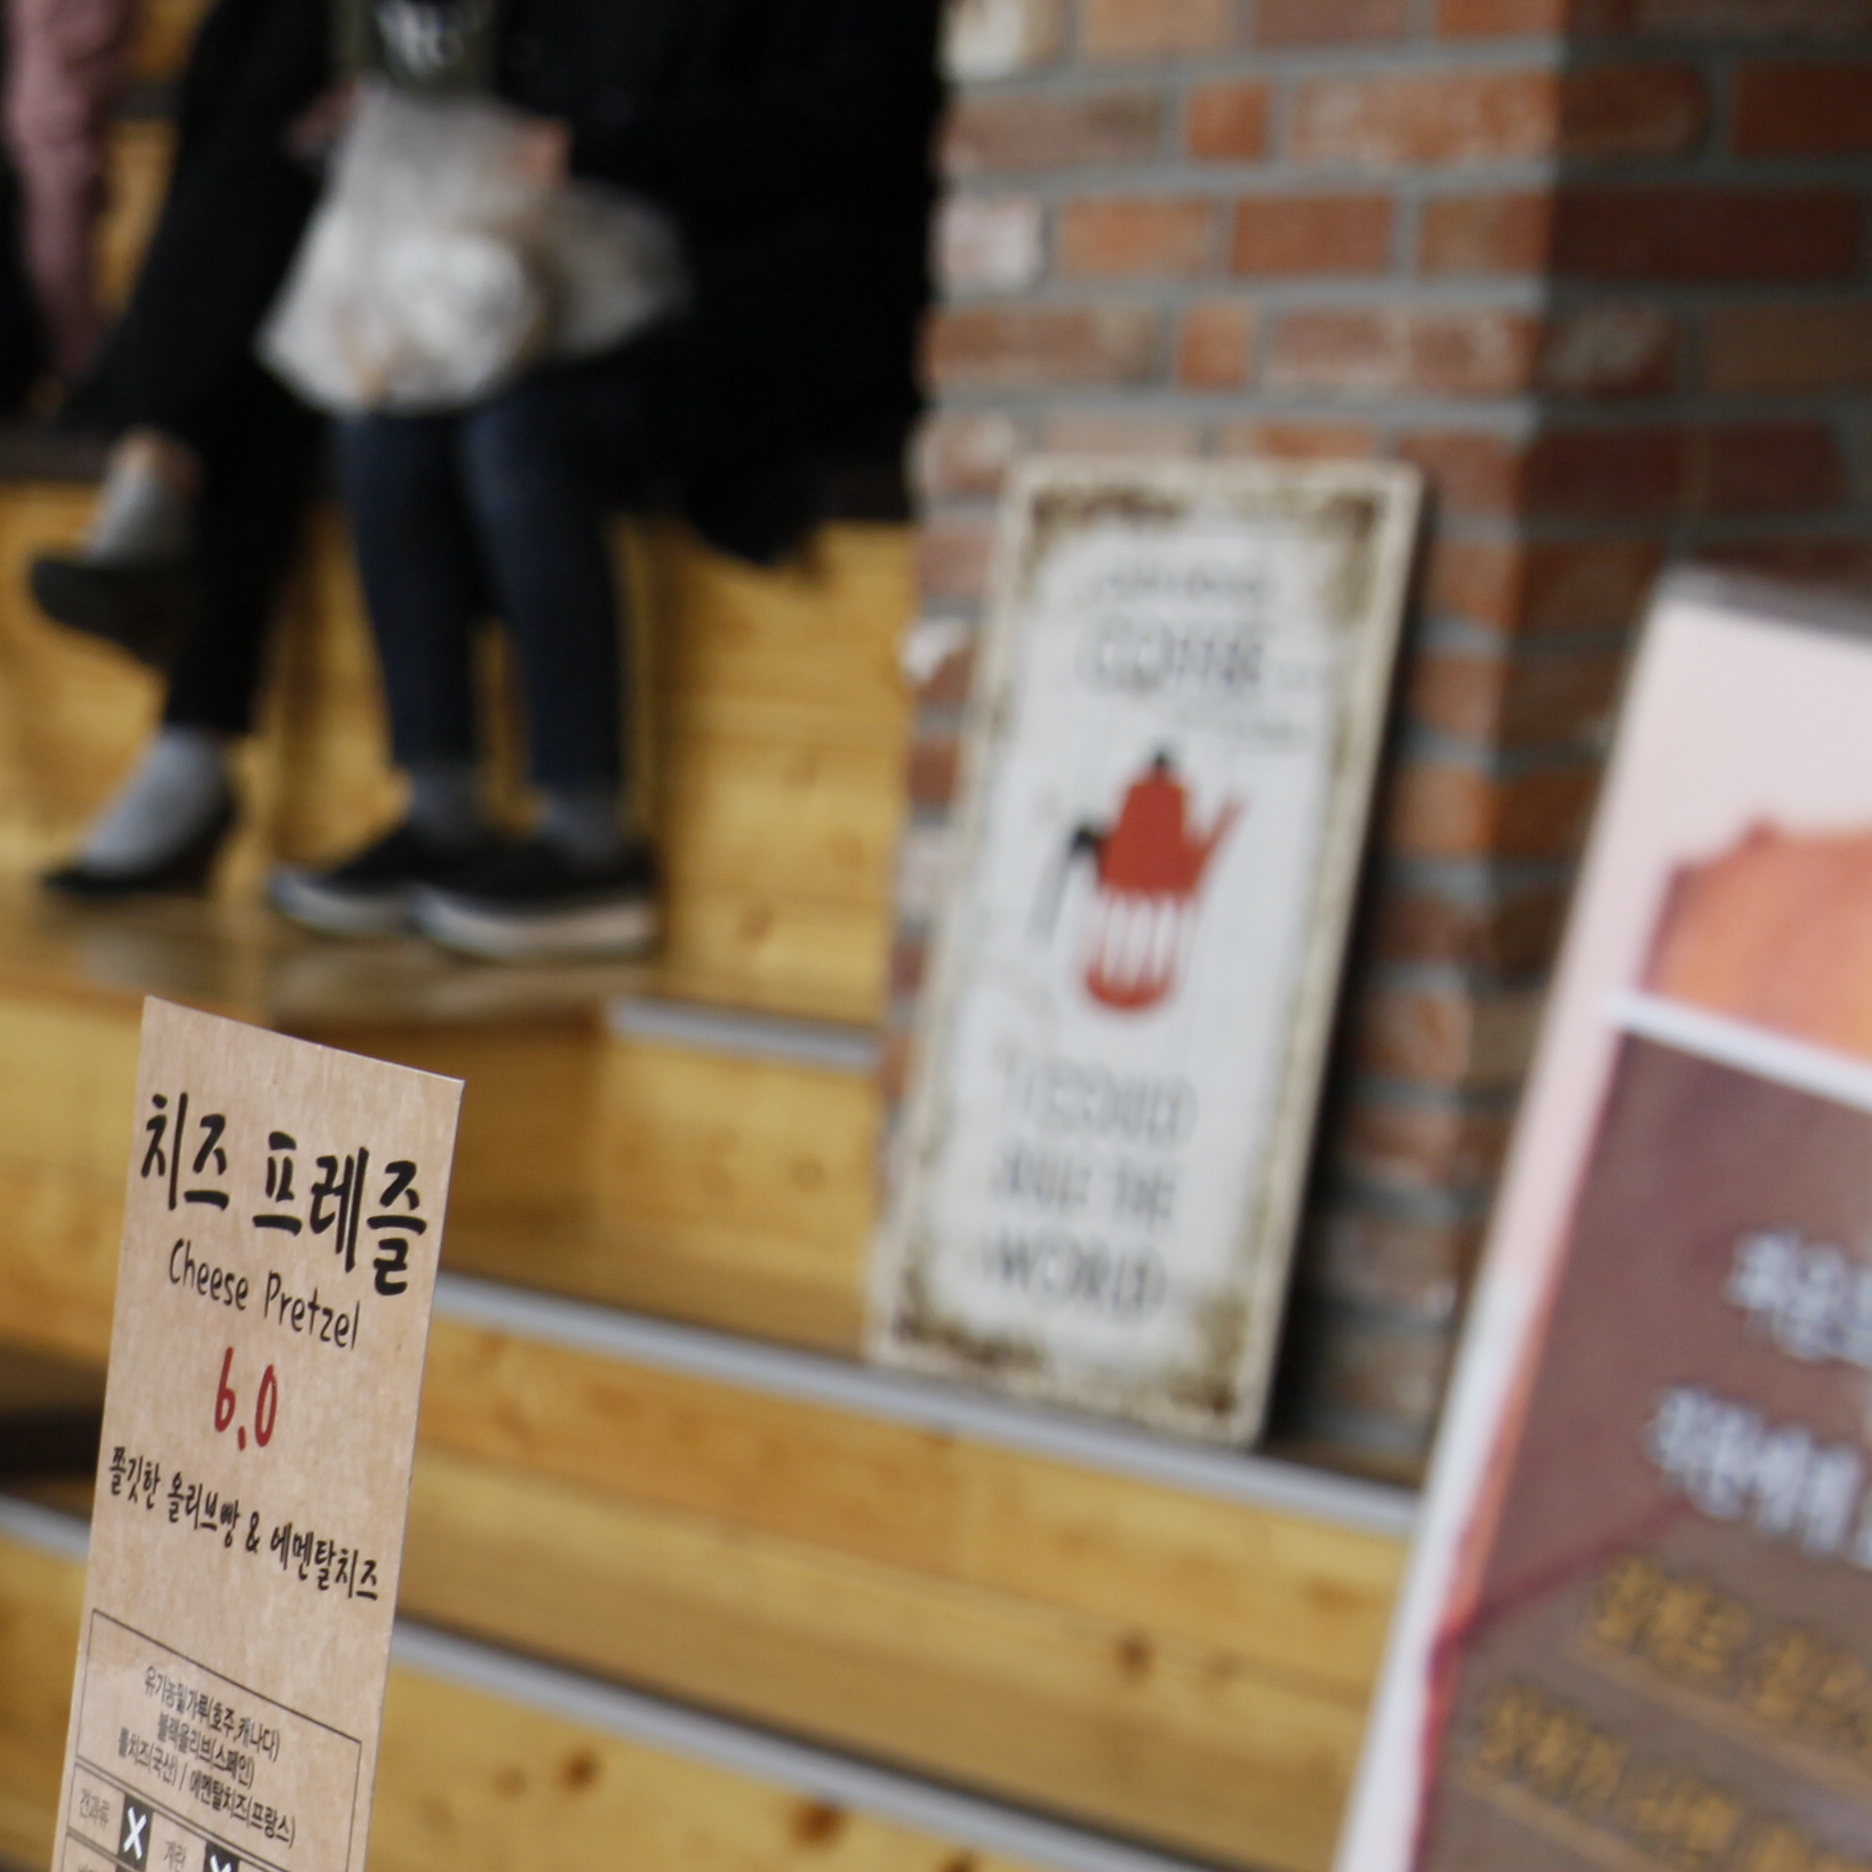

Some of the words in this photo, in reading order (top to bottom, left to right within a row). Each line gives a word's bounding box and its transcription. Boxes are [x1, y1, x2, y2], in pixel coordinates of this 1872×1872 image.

[141, 1091, 230, 1211] 치즈
[252, 1130, 427, 1296] 프레즐
[169, 1237, 249, 1311] Cheese
[264, 1269, 361, 1351] Pretzel
[214, 1346, 278, 1451] 6.0
[109, 1446, 161, 1510] 쫄깃한
[168, 1471, 240, 1548] 올리브빵
[245, 1511, 261, 1554] &
[270, 1521, 378, 1602] 에멘탈치즈
[80, 1788, 109, 1832] 건과류
[123, 1806, 147, 1861] X
